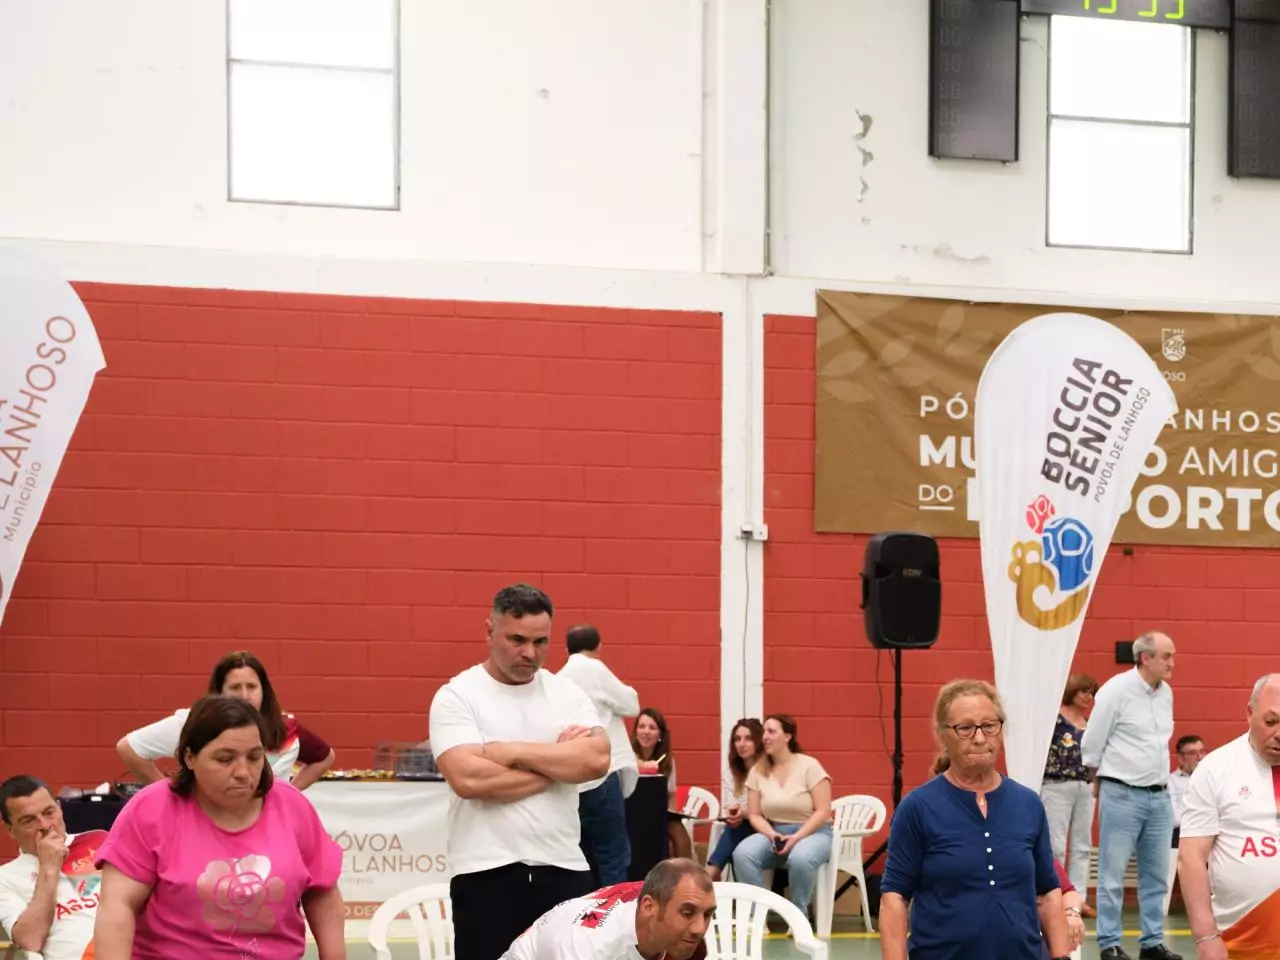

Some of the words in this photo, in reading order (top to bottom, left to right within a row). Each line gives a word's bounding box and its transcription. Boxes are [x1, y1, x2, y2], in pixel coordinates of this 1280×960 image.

[1040, 357, 1103, 484] BOCCIA
[1064, 369, 1133, 497] SENIOR
[1109, 441, 1125, 460] DE
[1117, 386, 1151, 442] LANHOSO
[918, 484, 954, 503] DO
[334, 830, 403, 852] ÓVOA
[352, 855, 446, 873] LANHOS
